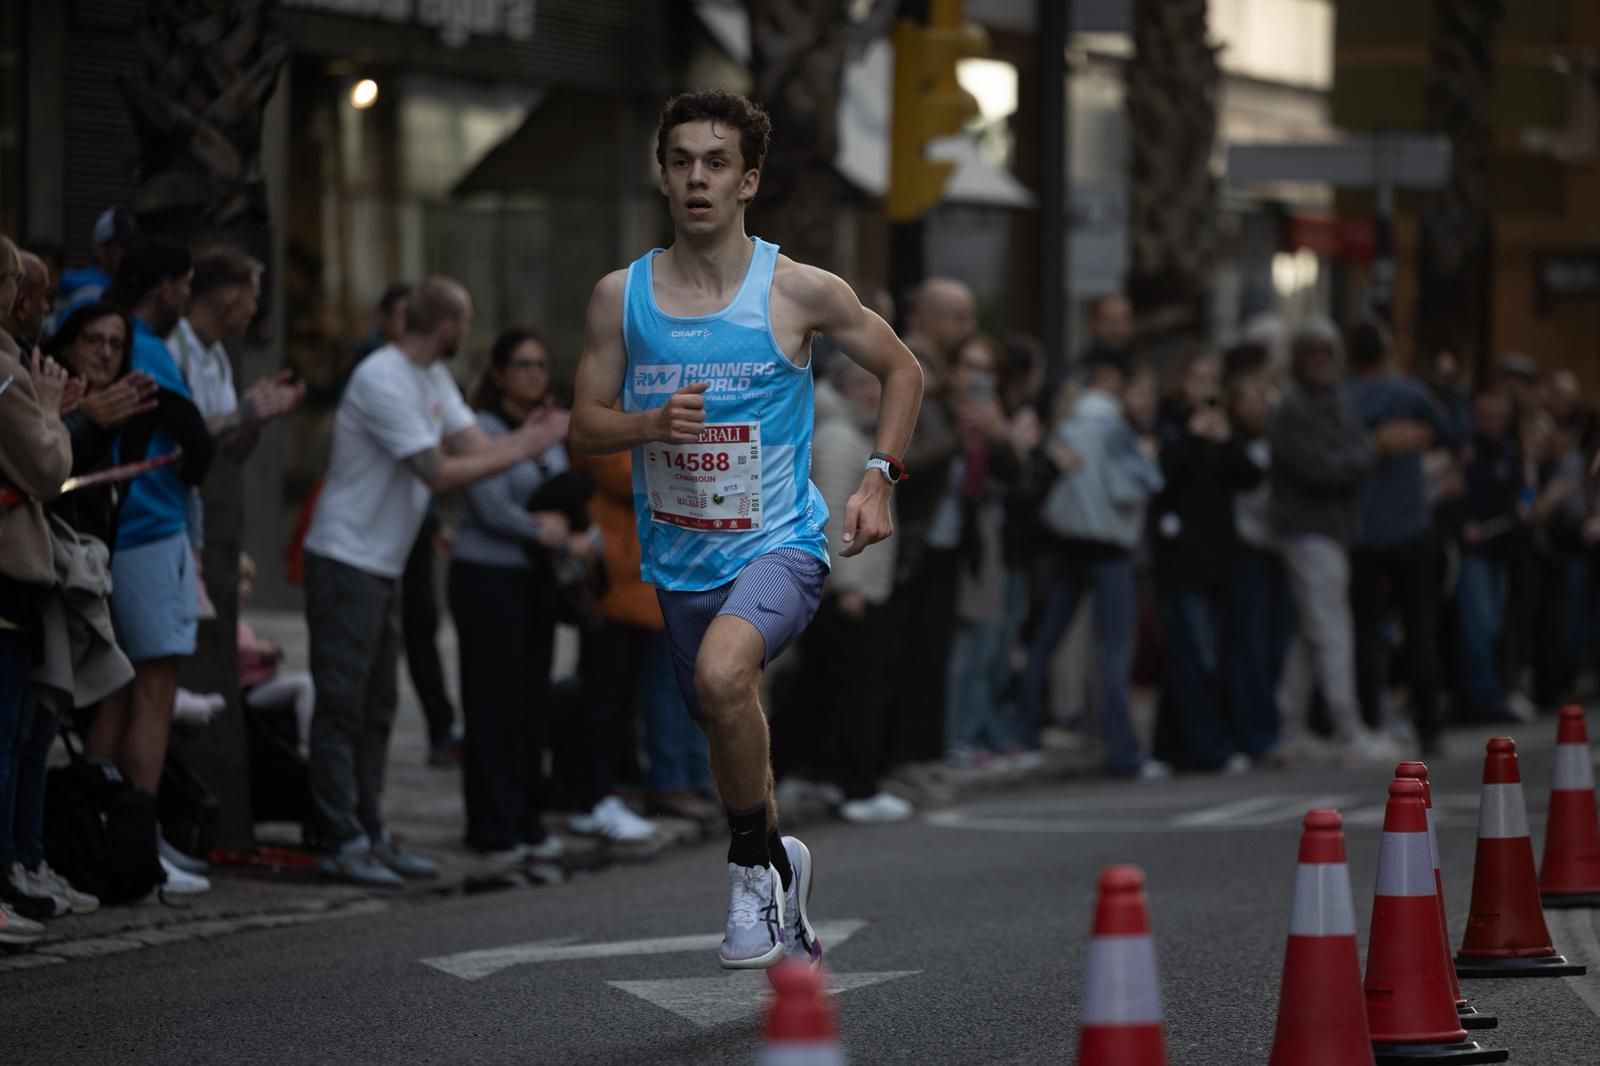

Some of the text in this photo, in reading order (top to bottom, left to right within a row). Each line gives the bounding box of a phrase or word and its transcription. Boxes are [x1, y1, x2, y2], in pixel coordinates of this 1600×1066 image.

[671, 329, 703, 338] CRAFT
[685, 362, 776, 378] RUNNERS
[698, 427, 741, 442] ERALI
[663, 451, 730, 471] 14588
